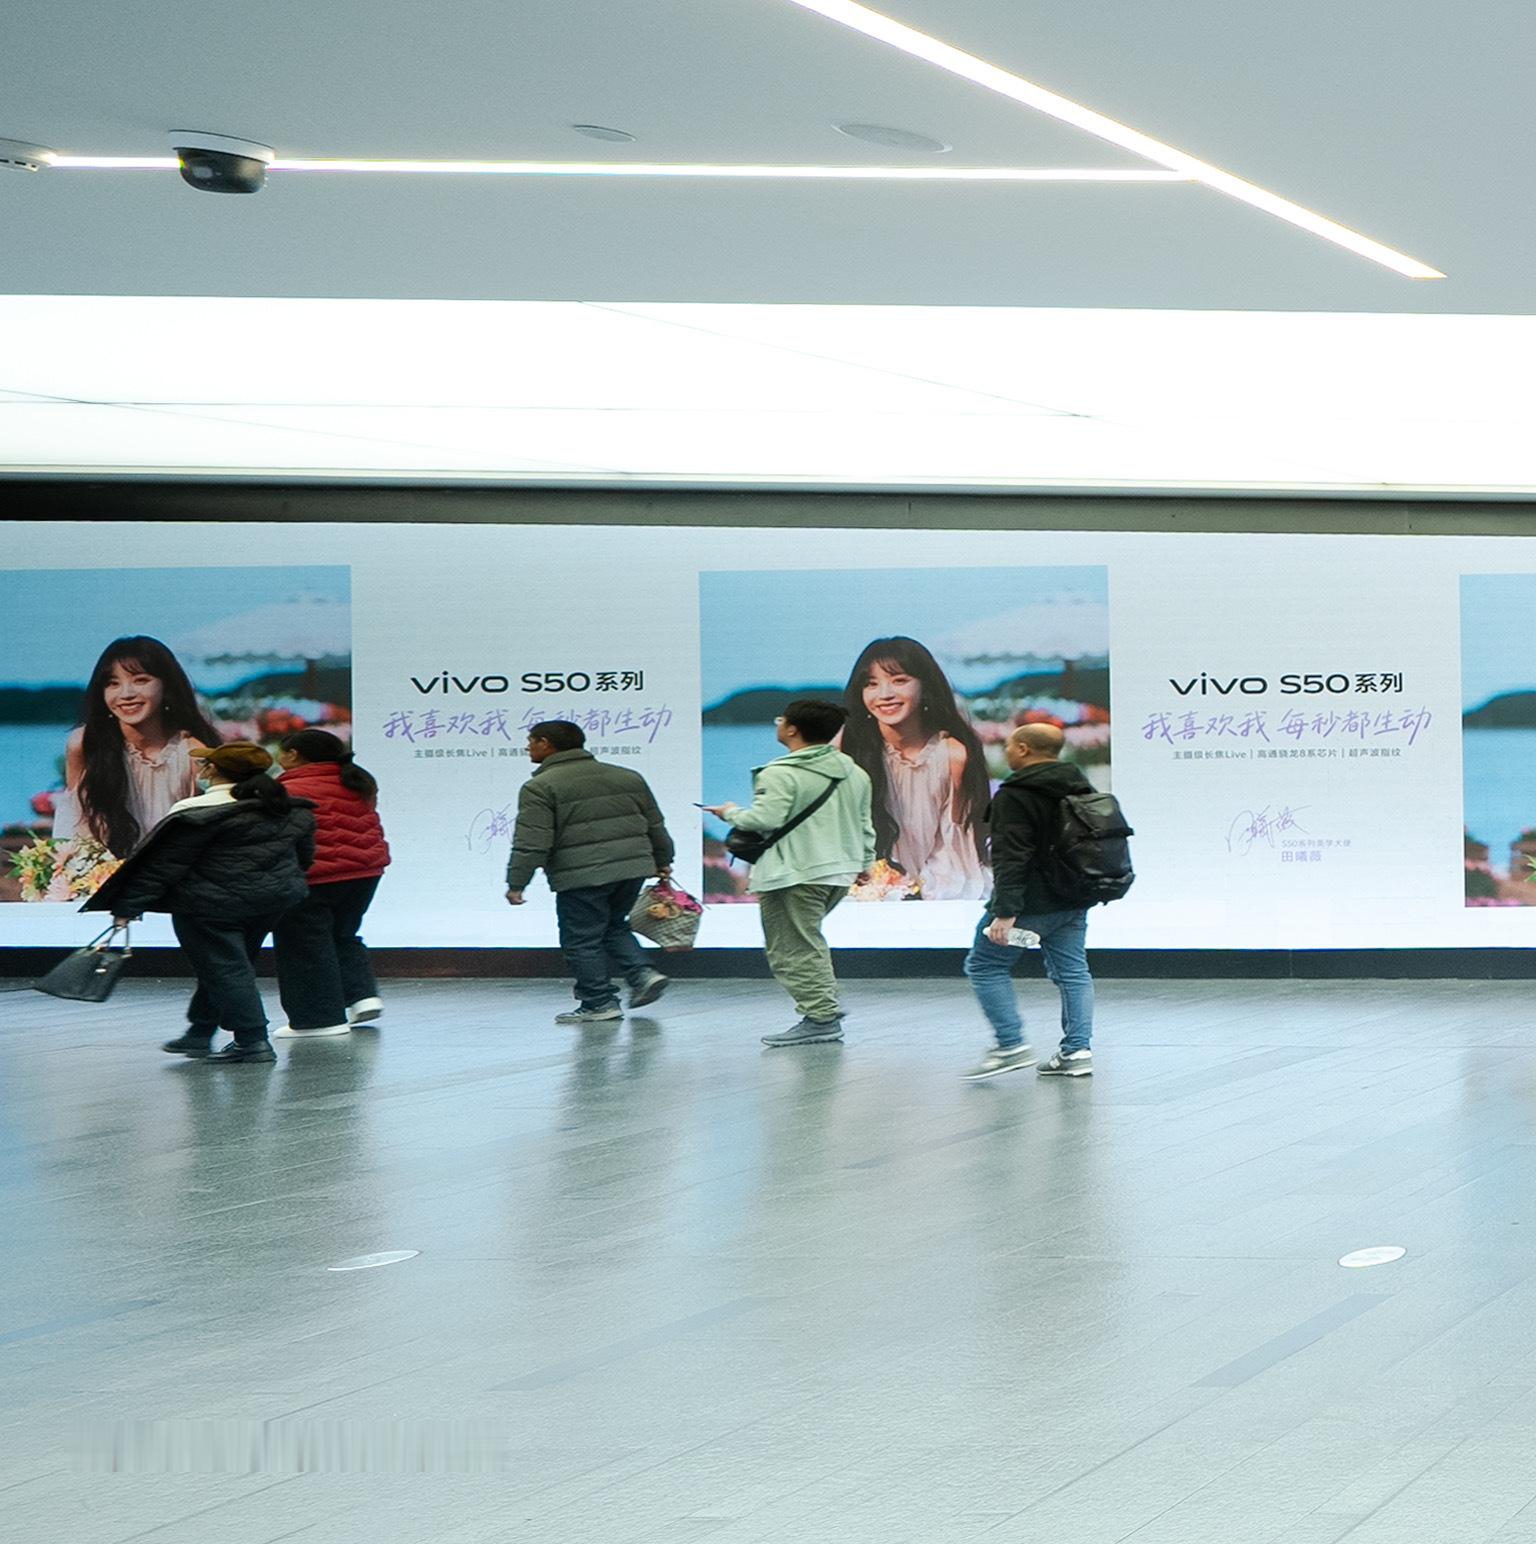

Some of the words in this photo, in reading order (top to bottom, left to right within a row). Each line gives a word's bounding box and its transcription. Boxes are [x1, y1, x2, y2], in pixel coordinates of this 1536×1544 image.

[410, 671, 510, 694] vivo
[521, 670, 644, 692] S50系列
[1169, 672, 1269, 695] vivo
[1280, 672, 1403, 694] S50系列
[383, 709, 512, 743] 我喜欢我
[1141, 710, 1270, 745] 我喜欢我
[1277, 705, 1432, 745] 每秒都生动
